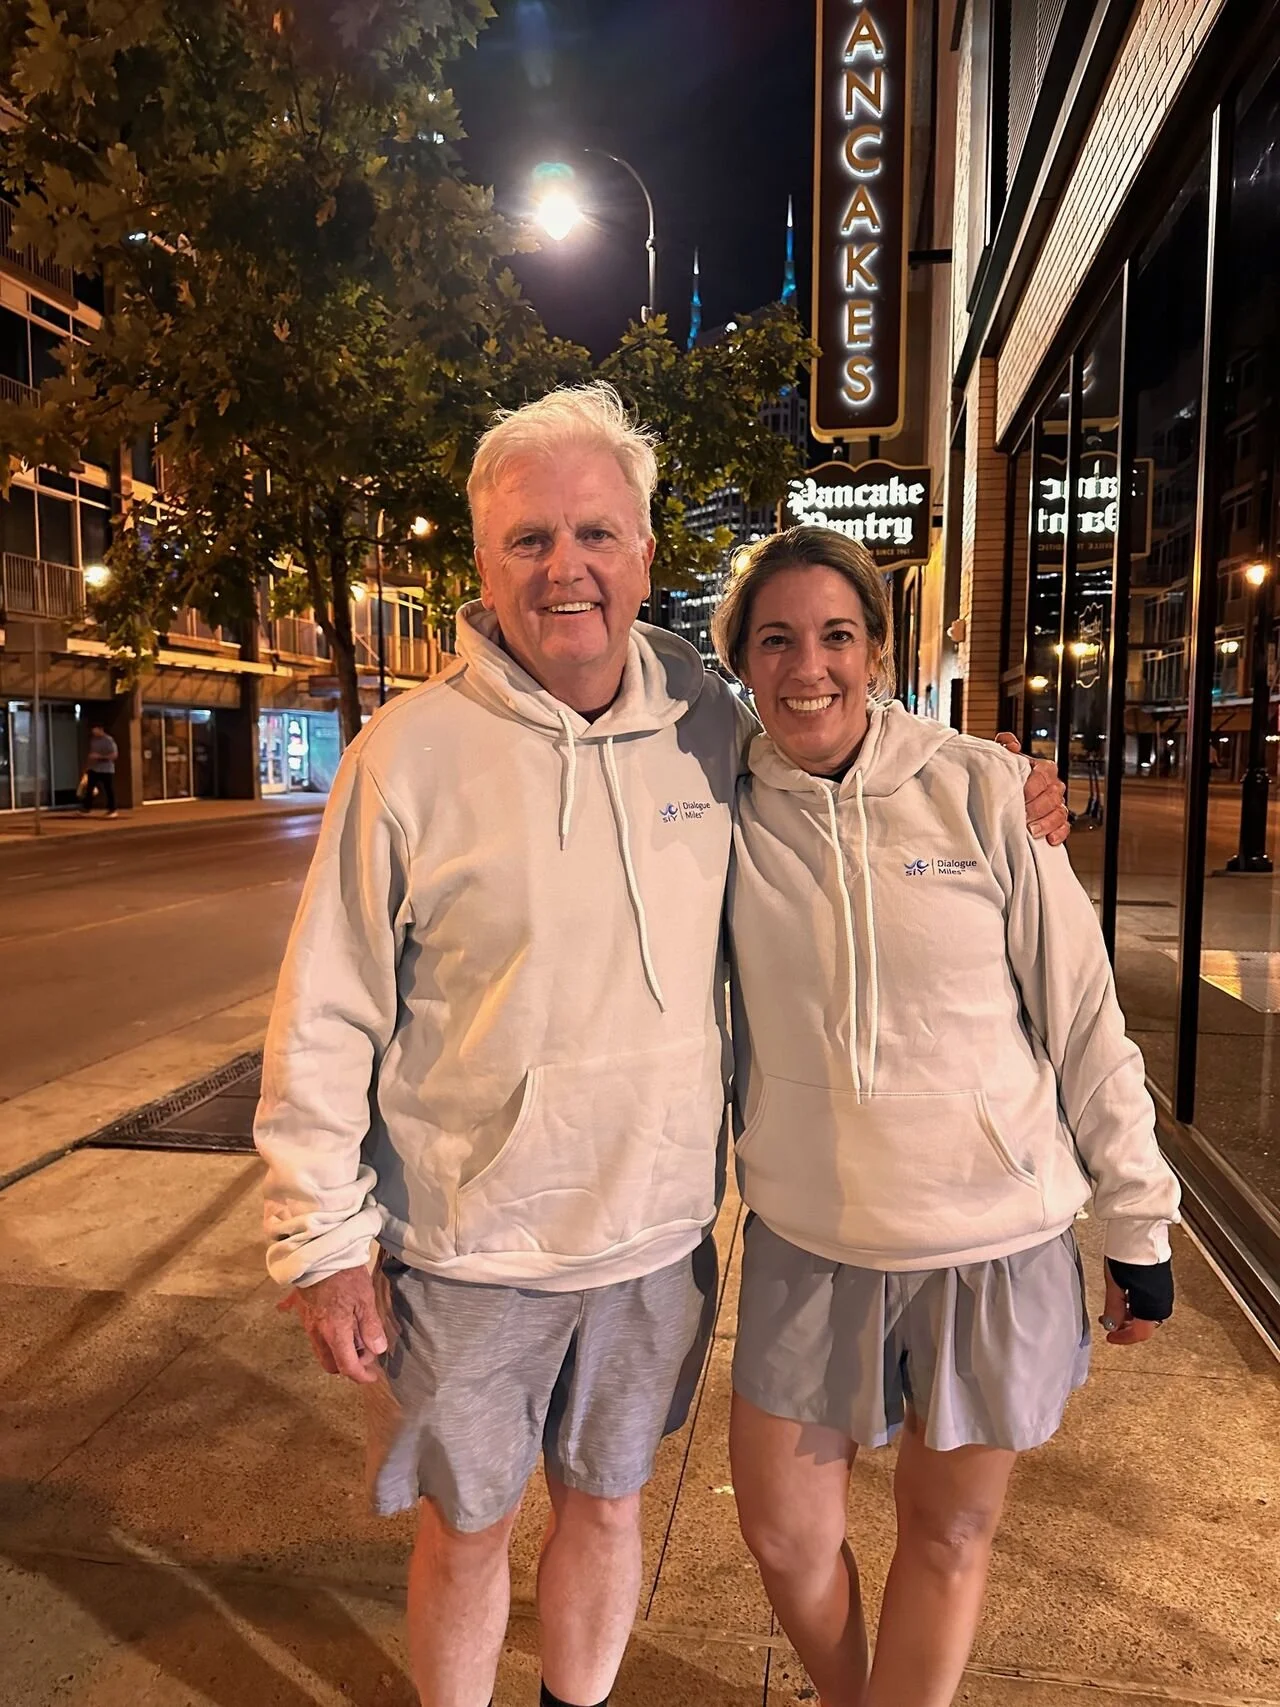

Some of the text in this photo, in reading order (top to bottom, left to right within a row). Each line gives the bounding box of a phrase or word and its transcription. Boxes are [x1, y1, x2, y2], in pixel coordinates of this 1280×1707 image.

[841, 0, 885, 405] ANCAKES
[786, 476, 925, 516] Pancake
[682, 801, 710, 811] Dialogue
[937, 860, 977, 869] Dialogue
